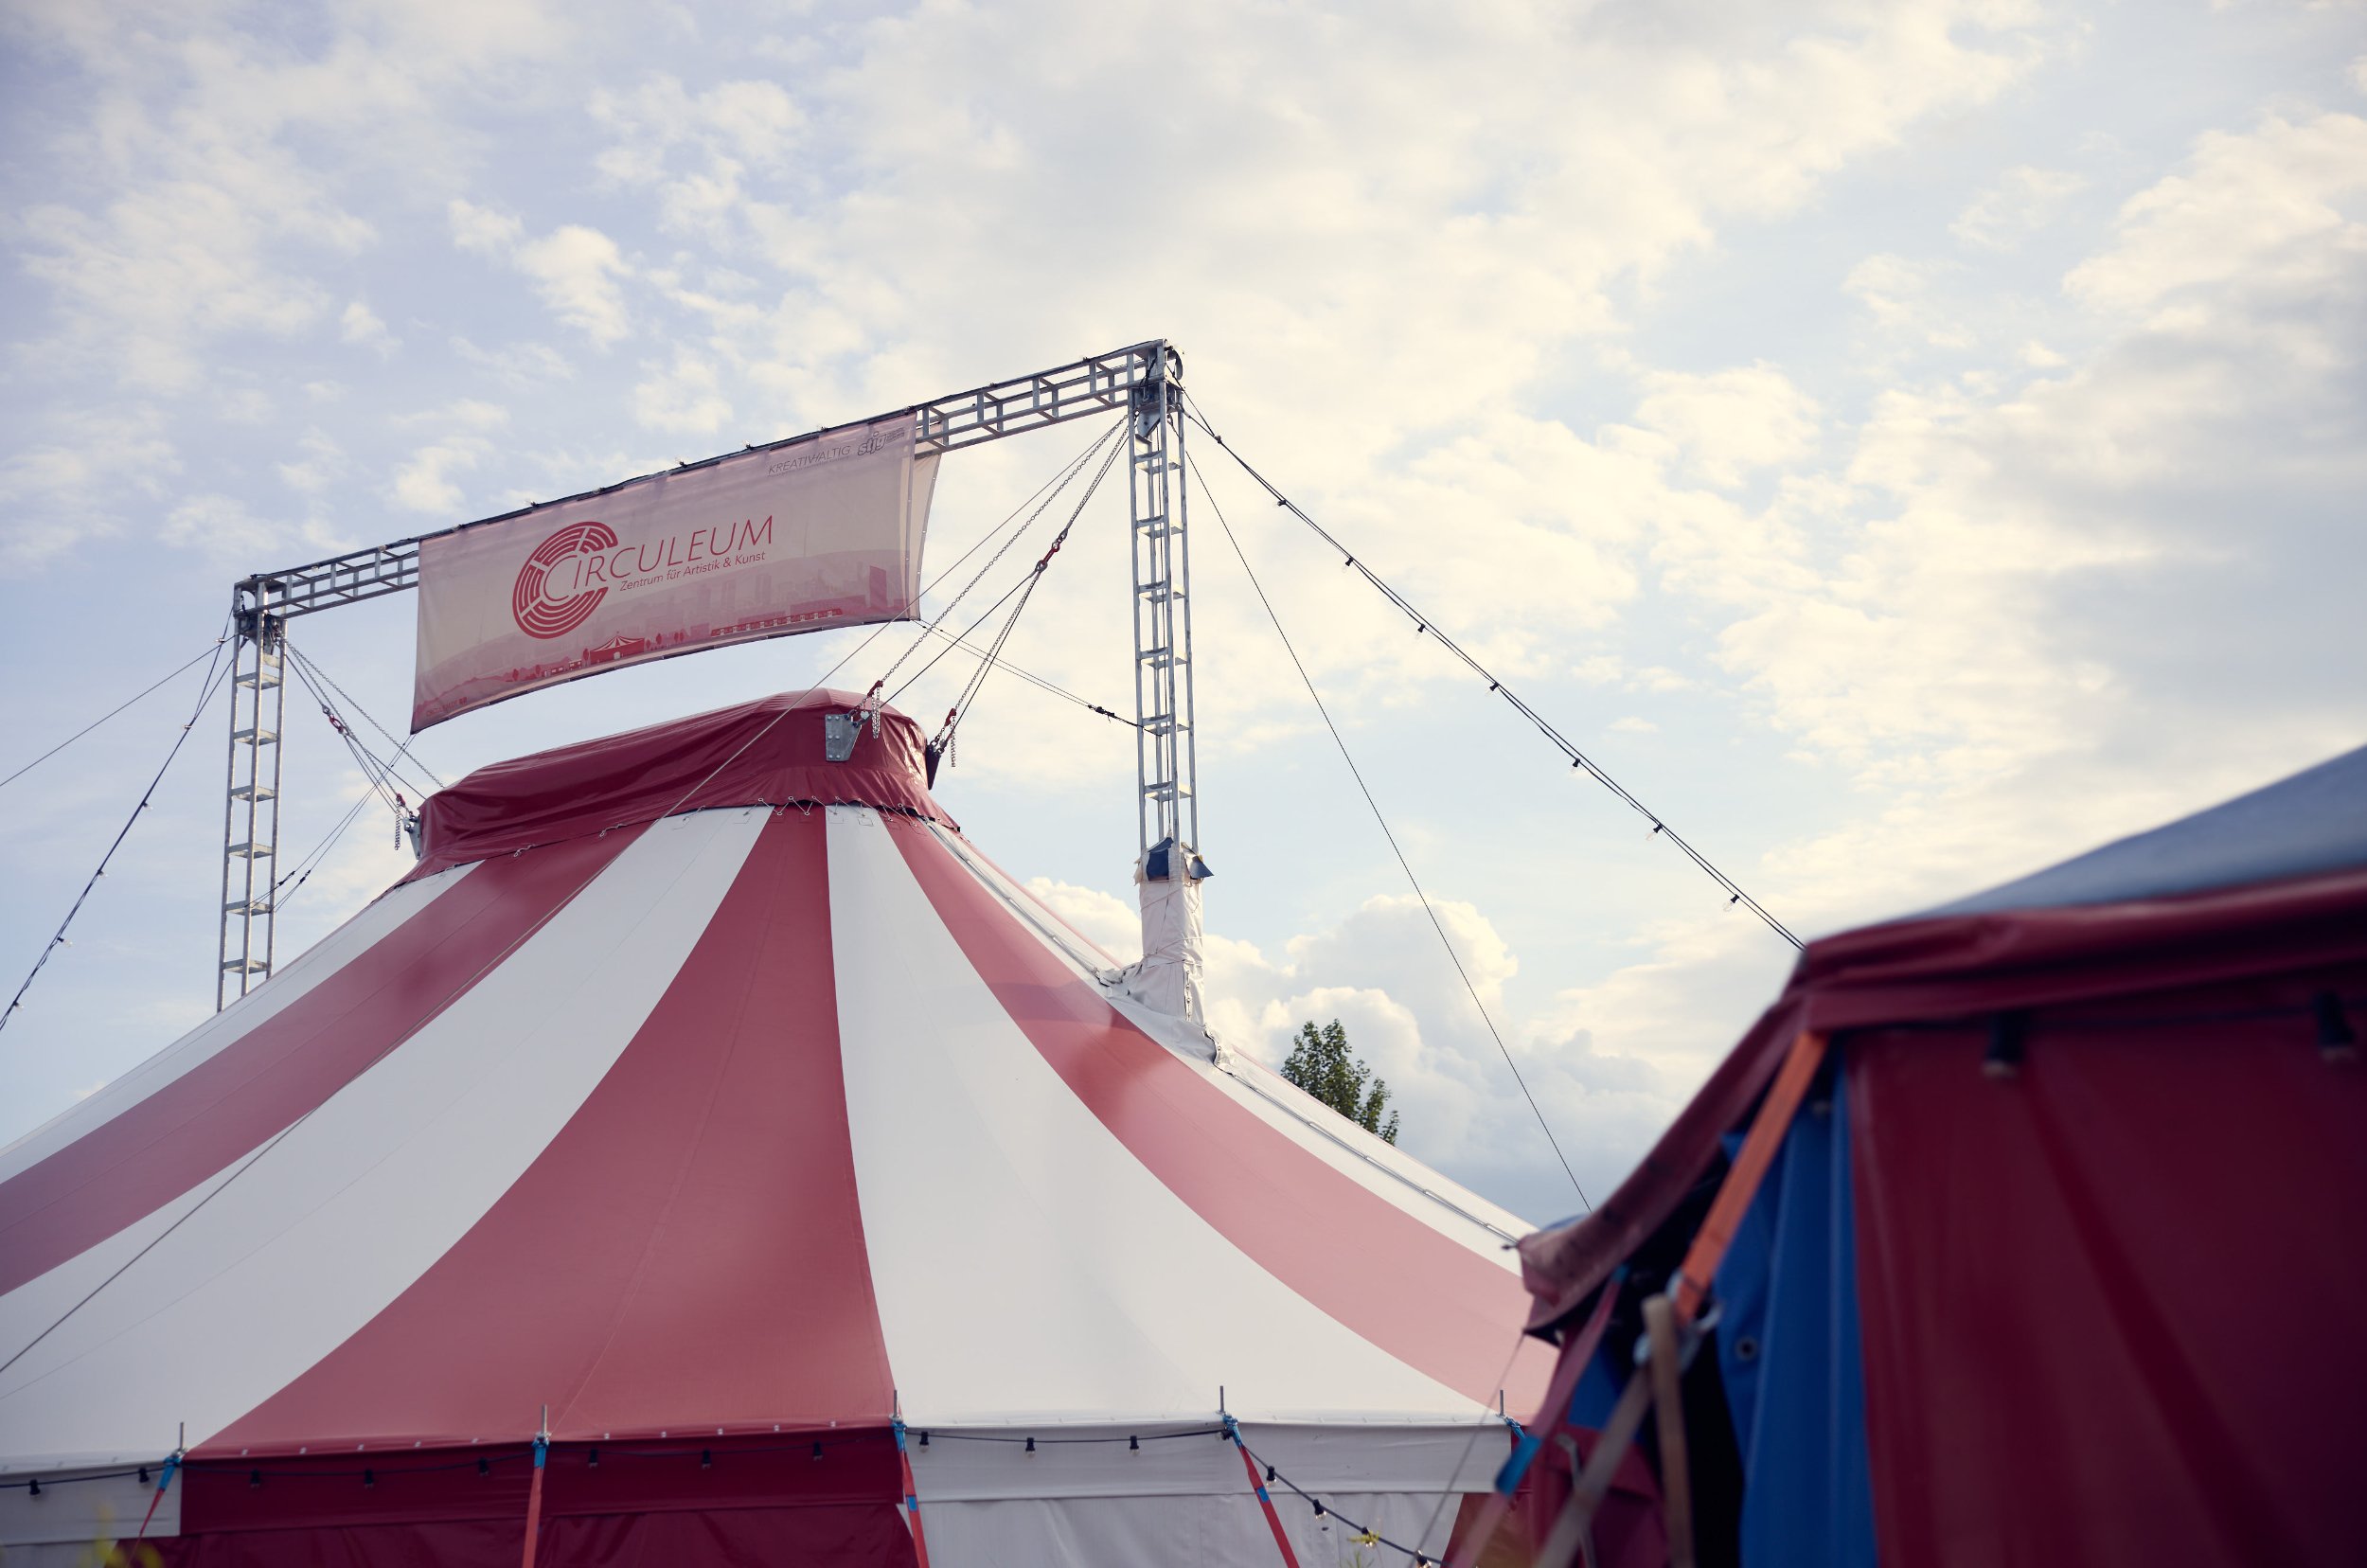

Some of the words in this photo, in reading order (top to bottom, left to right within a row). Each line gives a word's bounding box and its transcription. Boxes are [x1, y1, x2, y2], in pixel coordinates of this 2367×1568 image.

[543, 514, 774, 602] CIRCULEUM
[619, 574, 664, 592] Zentrum
[666, 569, 681, 581] für
[683, 560, 721, 578] Artistik
[722, 557, 732, 568] &
[735, 551, 766, 566] Kunst
